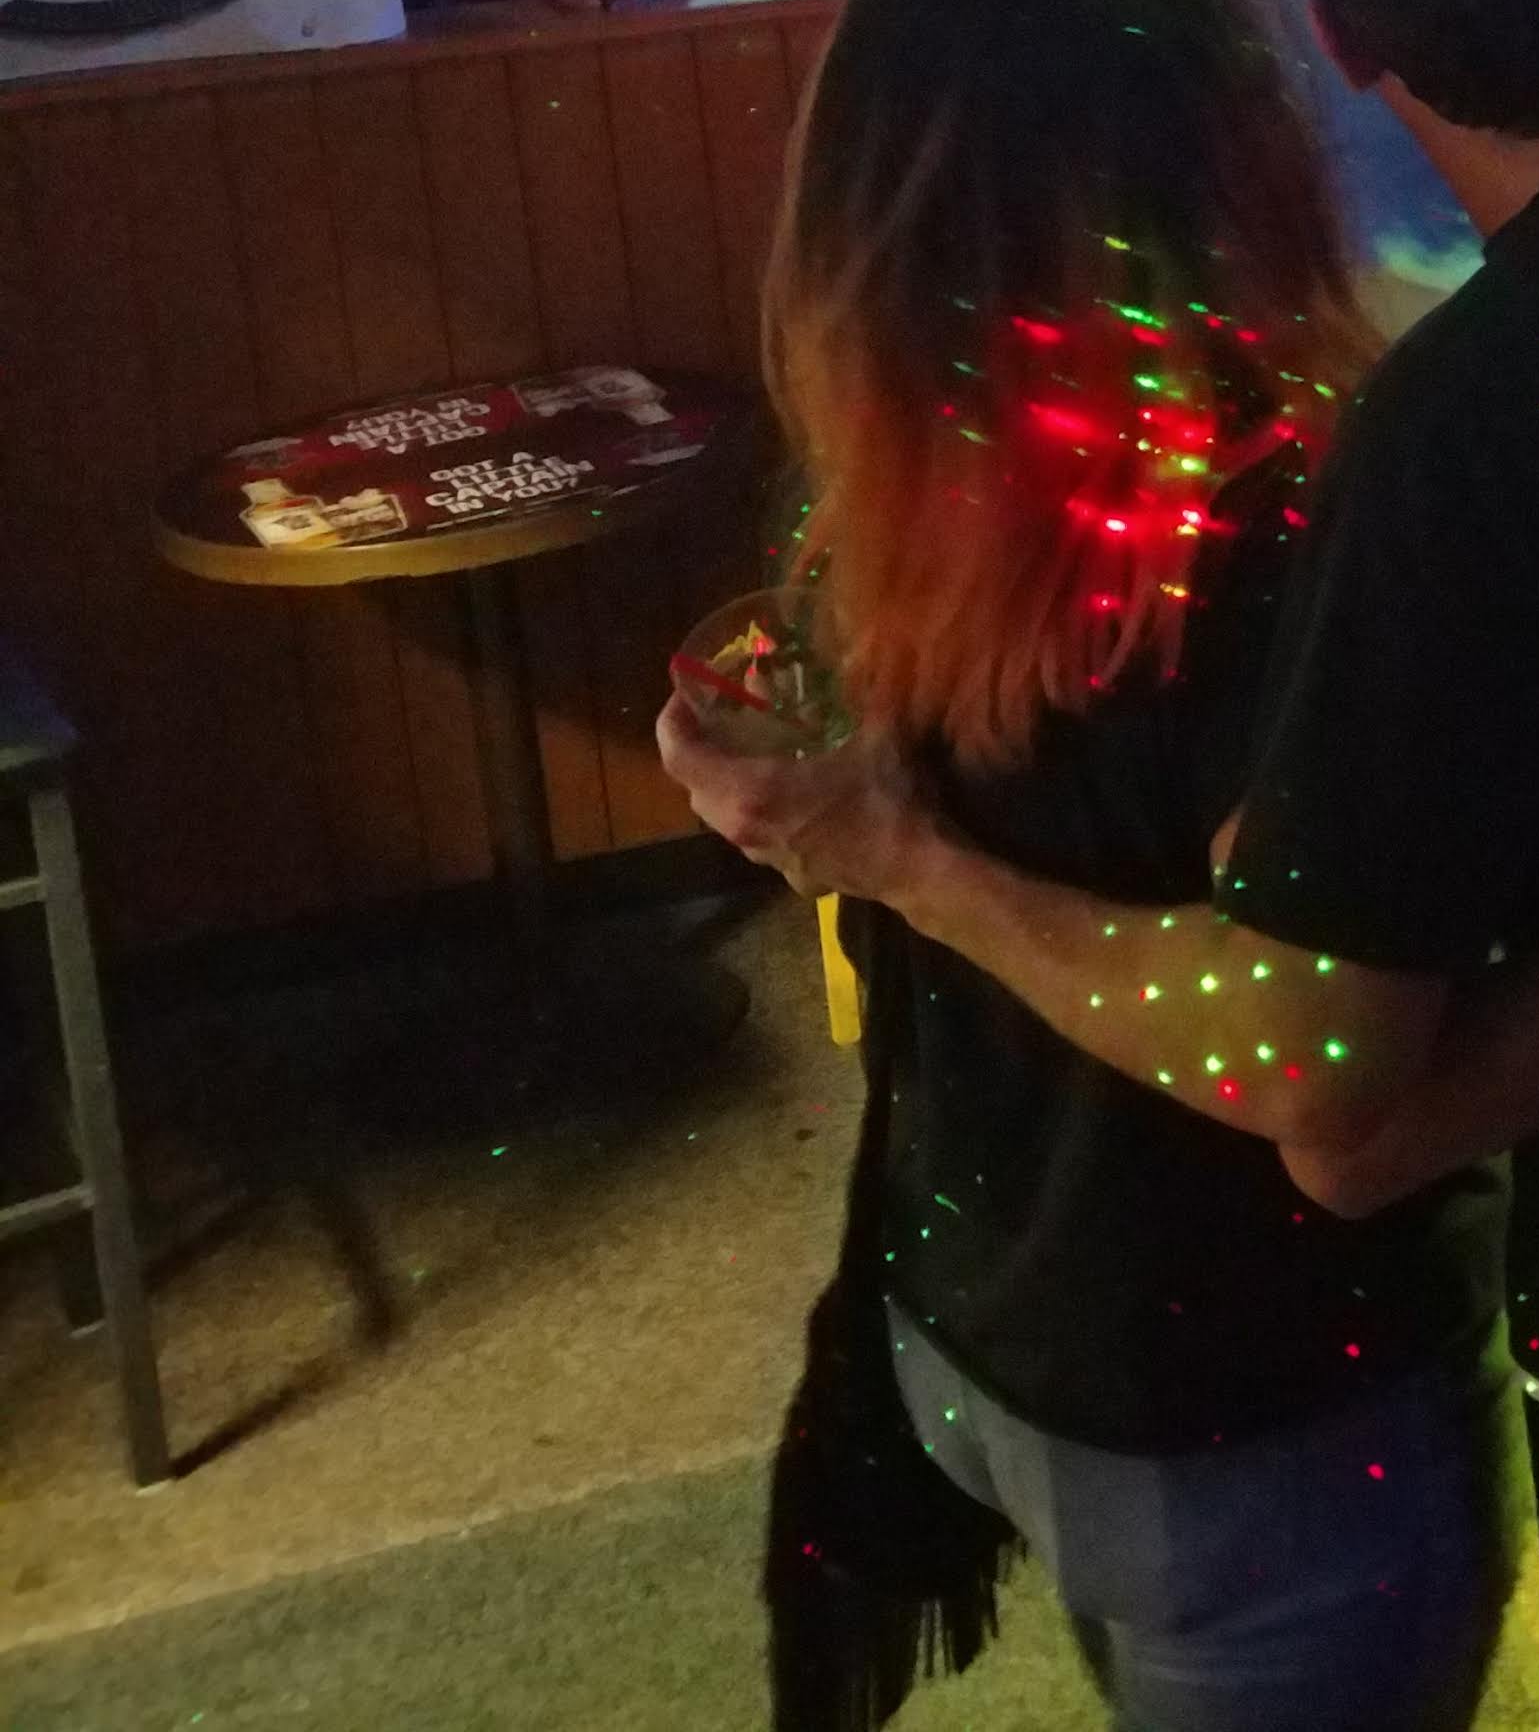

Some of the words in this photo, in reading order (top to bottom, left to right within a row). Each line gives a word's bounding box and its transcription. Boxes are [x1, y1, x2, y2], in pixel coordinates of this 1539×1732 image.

[429, 458, 496, 482] GOT
[512, 451, 536, 465] A
[449, 455, 562, 490] LITTLE
[425, 459, 596, 508] CAPTAIN
[445, 498, 485, 515] IN
